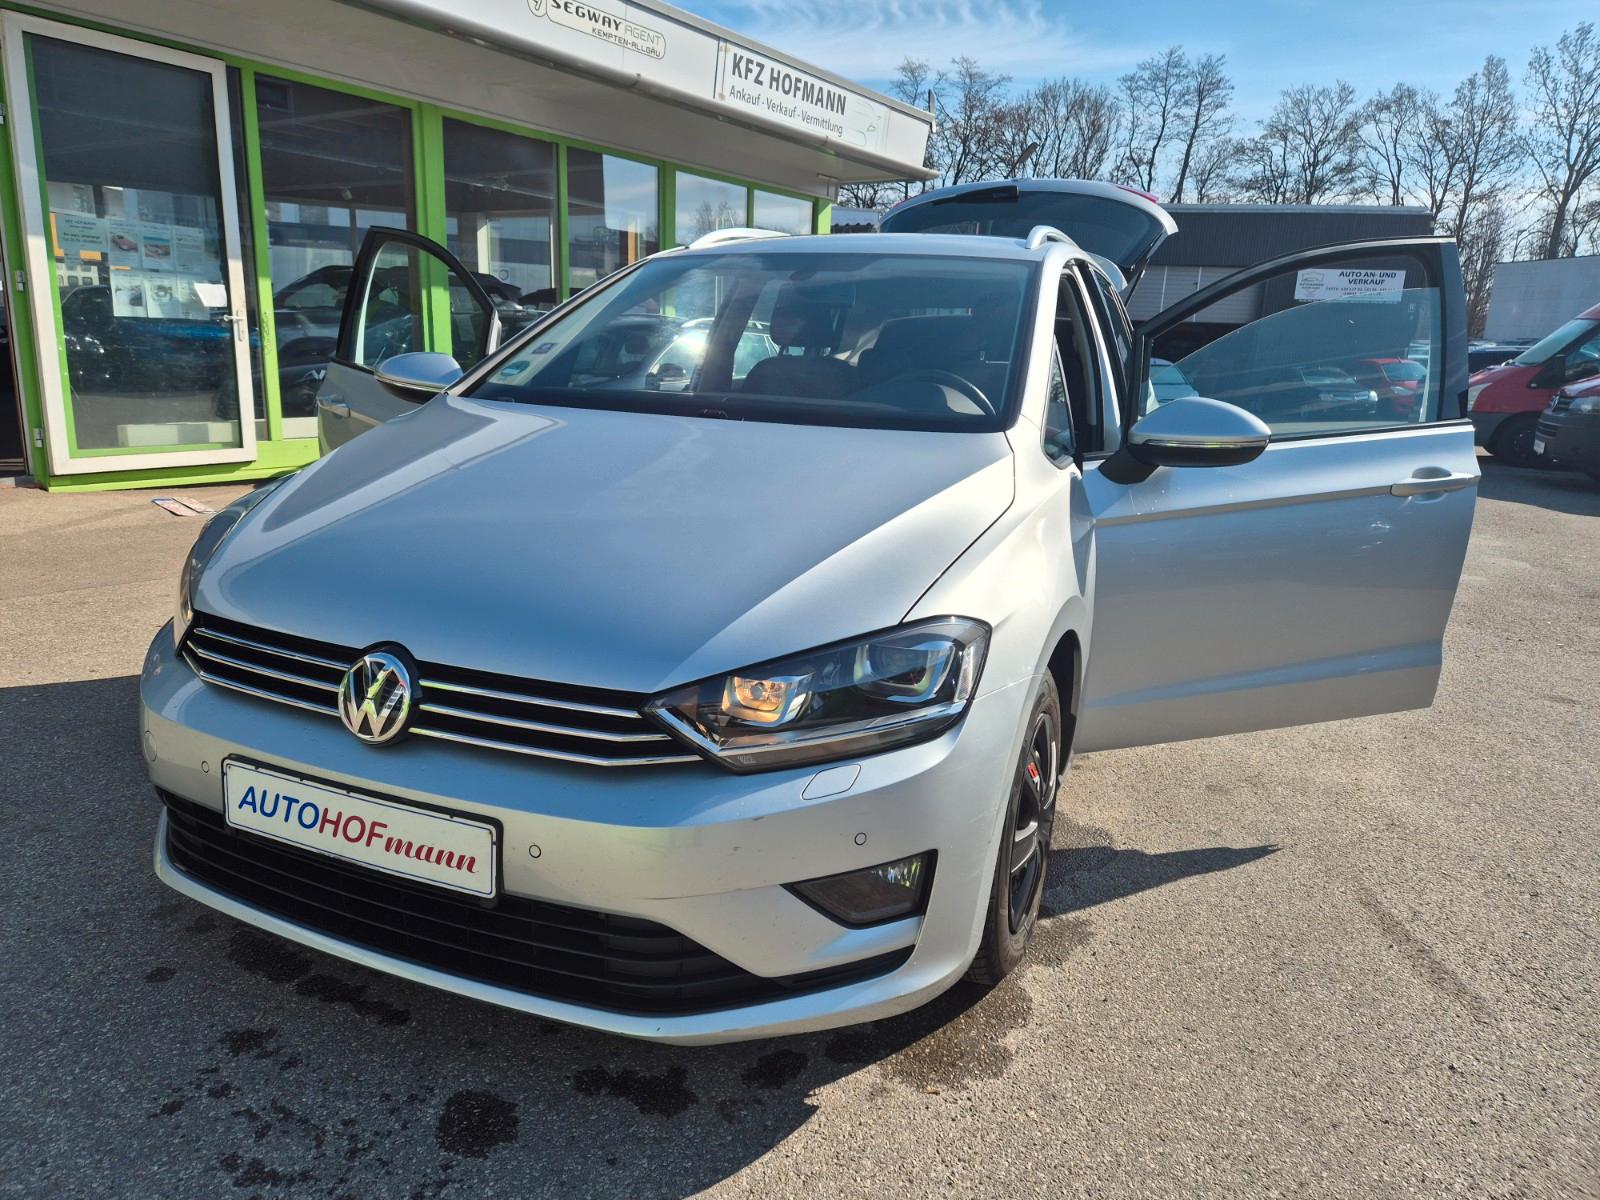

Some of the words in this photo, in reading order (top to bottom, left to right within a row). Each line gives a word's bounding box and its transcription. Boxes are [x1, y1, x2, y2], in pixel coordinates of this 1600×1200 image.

[552, 0, 621, 31] SEGWAY
[624, 24, 661, 46] AGENT
[732, 53, 765, 86] KFZ
[769, 67, 846, 115] HOFMANN
[729, 85, 760, 106] Ankauf
[766, 97, 796, 119] Verkauf
[801, 110, 843, 137] Vermittlung
[1348, 278, 1386, 286] VERKAUF
[1379, 271, 1397, 279] UND
[238, 785, 480, 874] AUTOHOFmann
